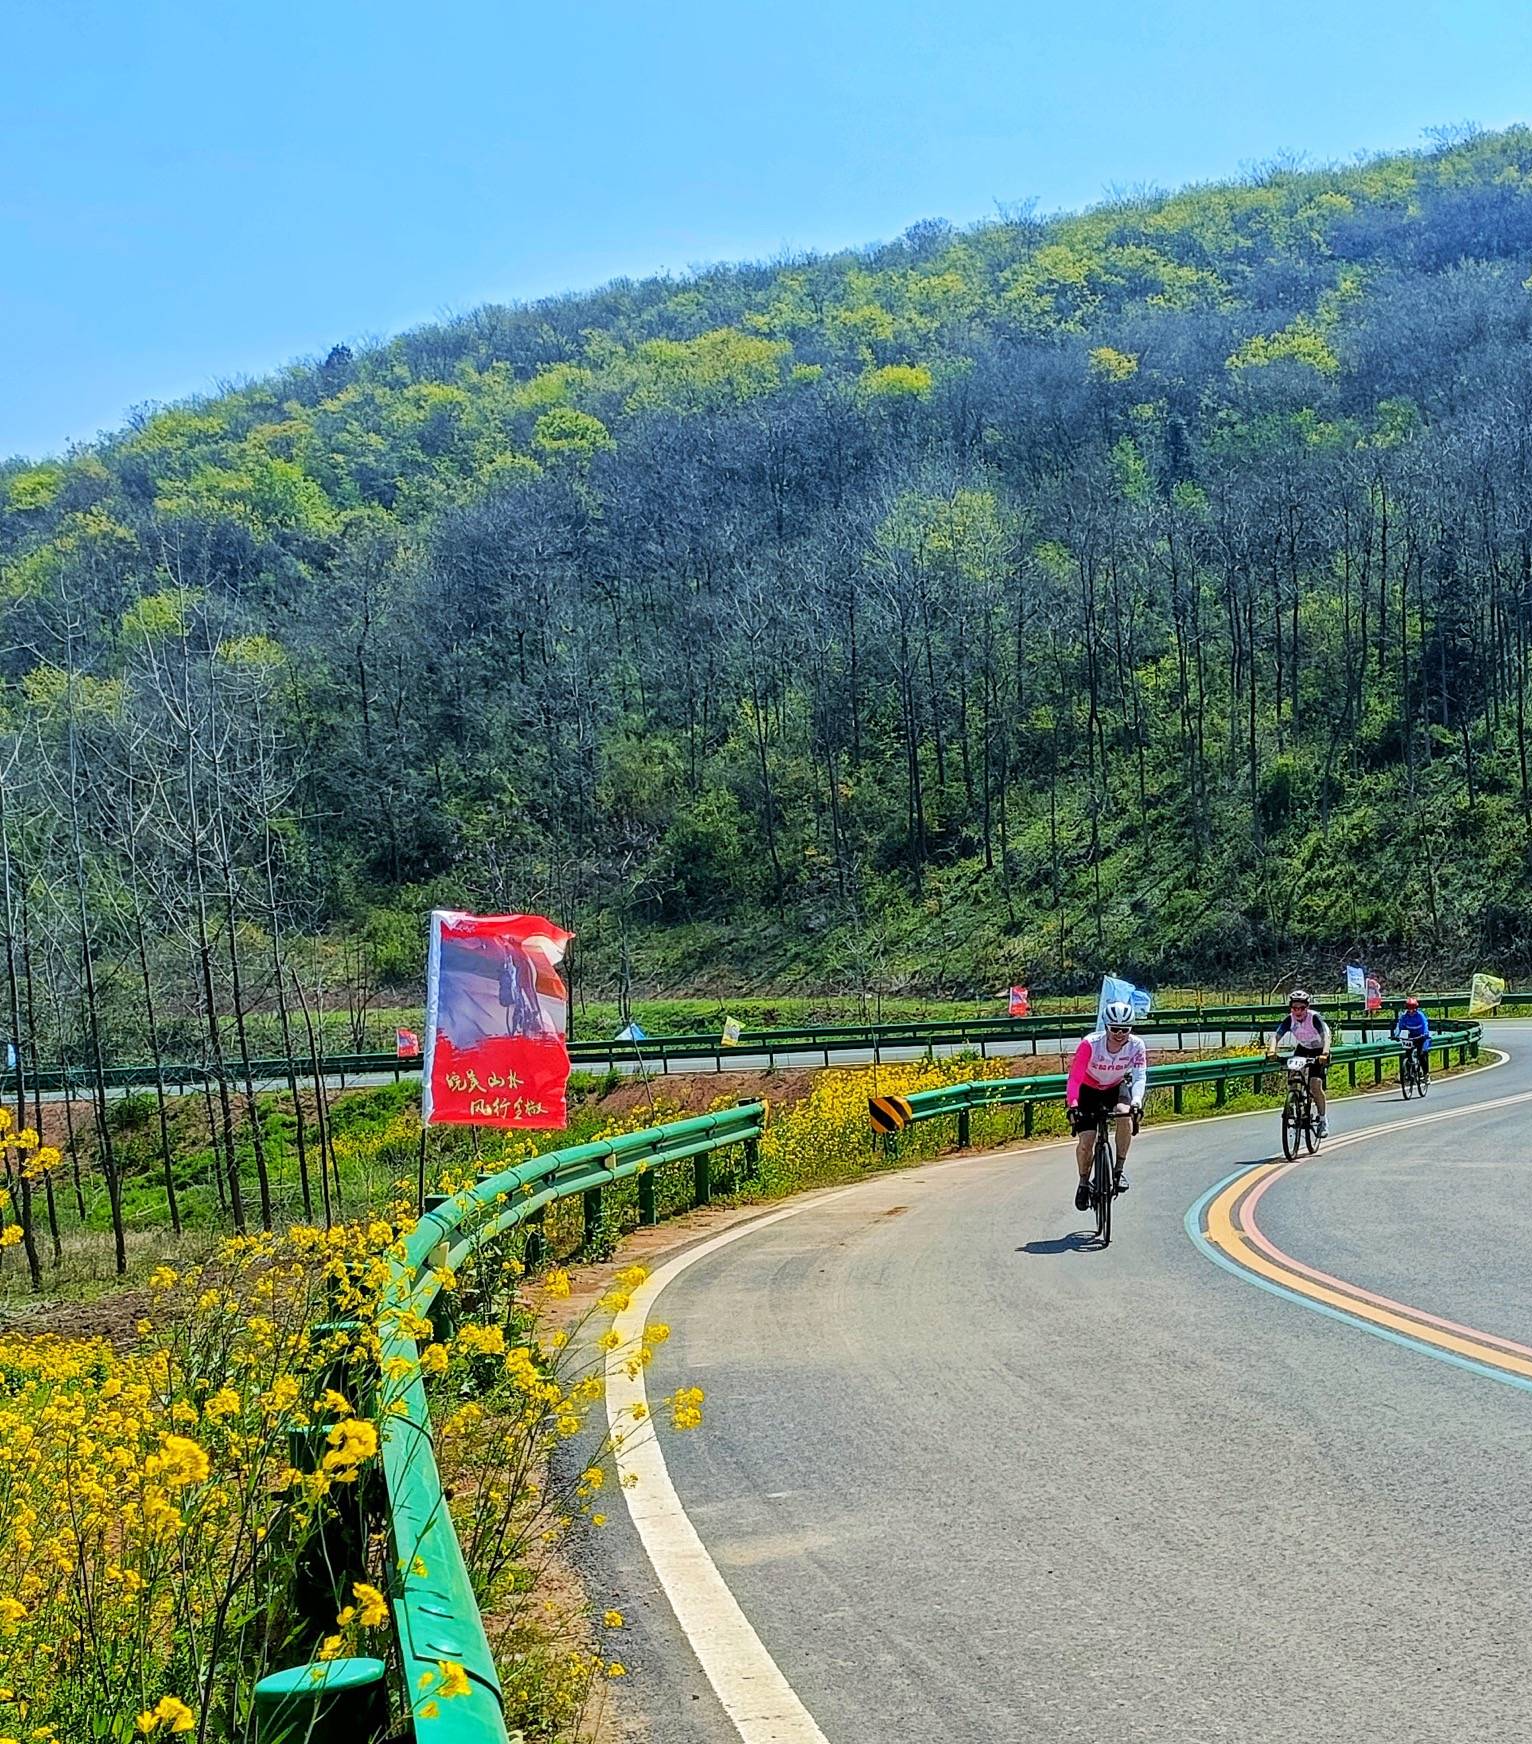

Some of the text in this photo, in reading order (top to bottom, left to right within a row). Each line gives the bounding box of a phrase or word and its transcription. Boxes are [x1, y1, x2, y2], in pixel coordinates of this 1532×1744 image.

[445, 1069, 525, 1093] 皖美山水
[470, 1096, 549, 1120] 风行全椒
